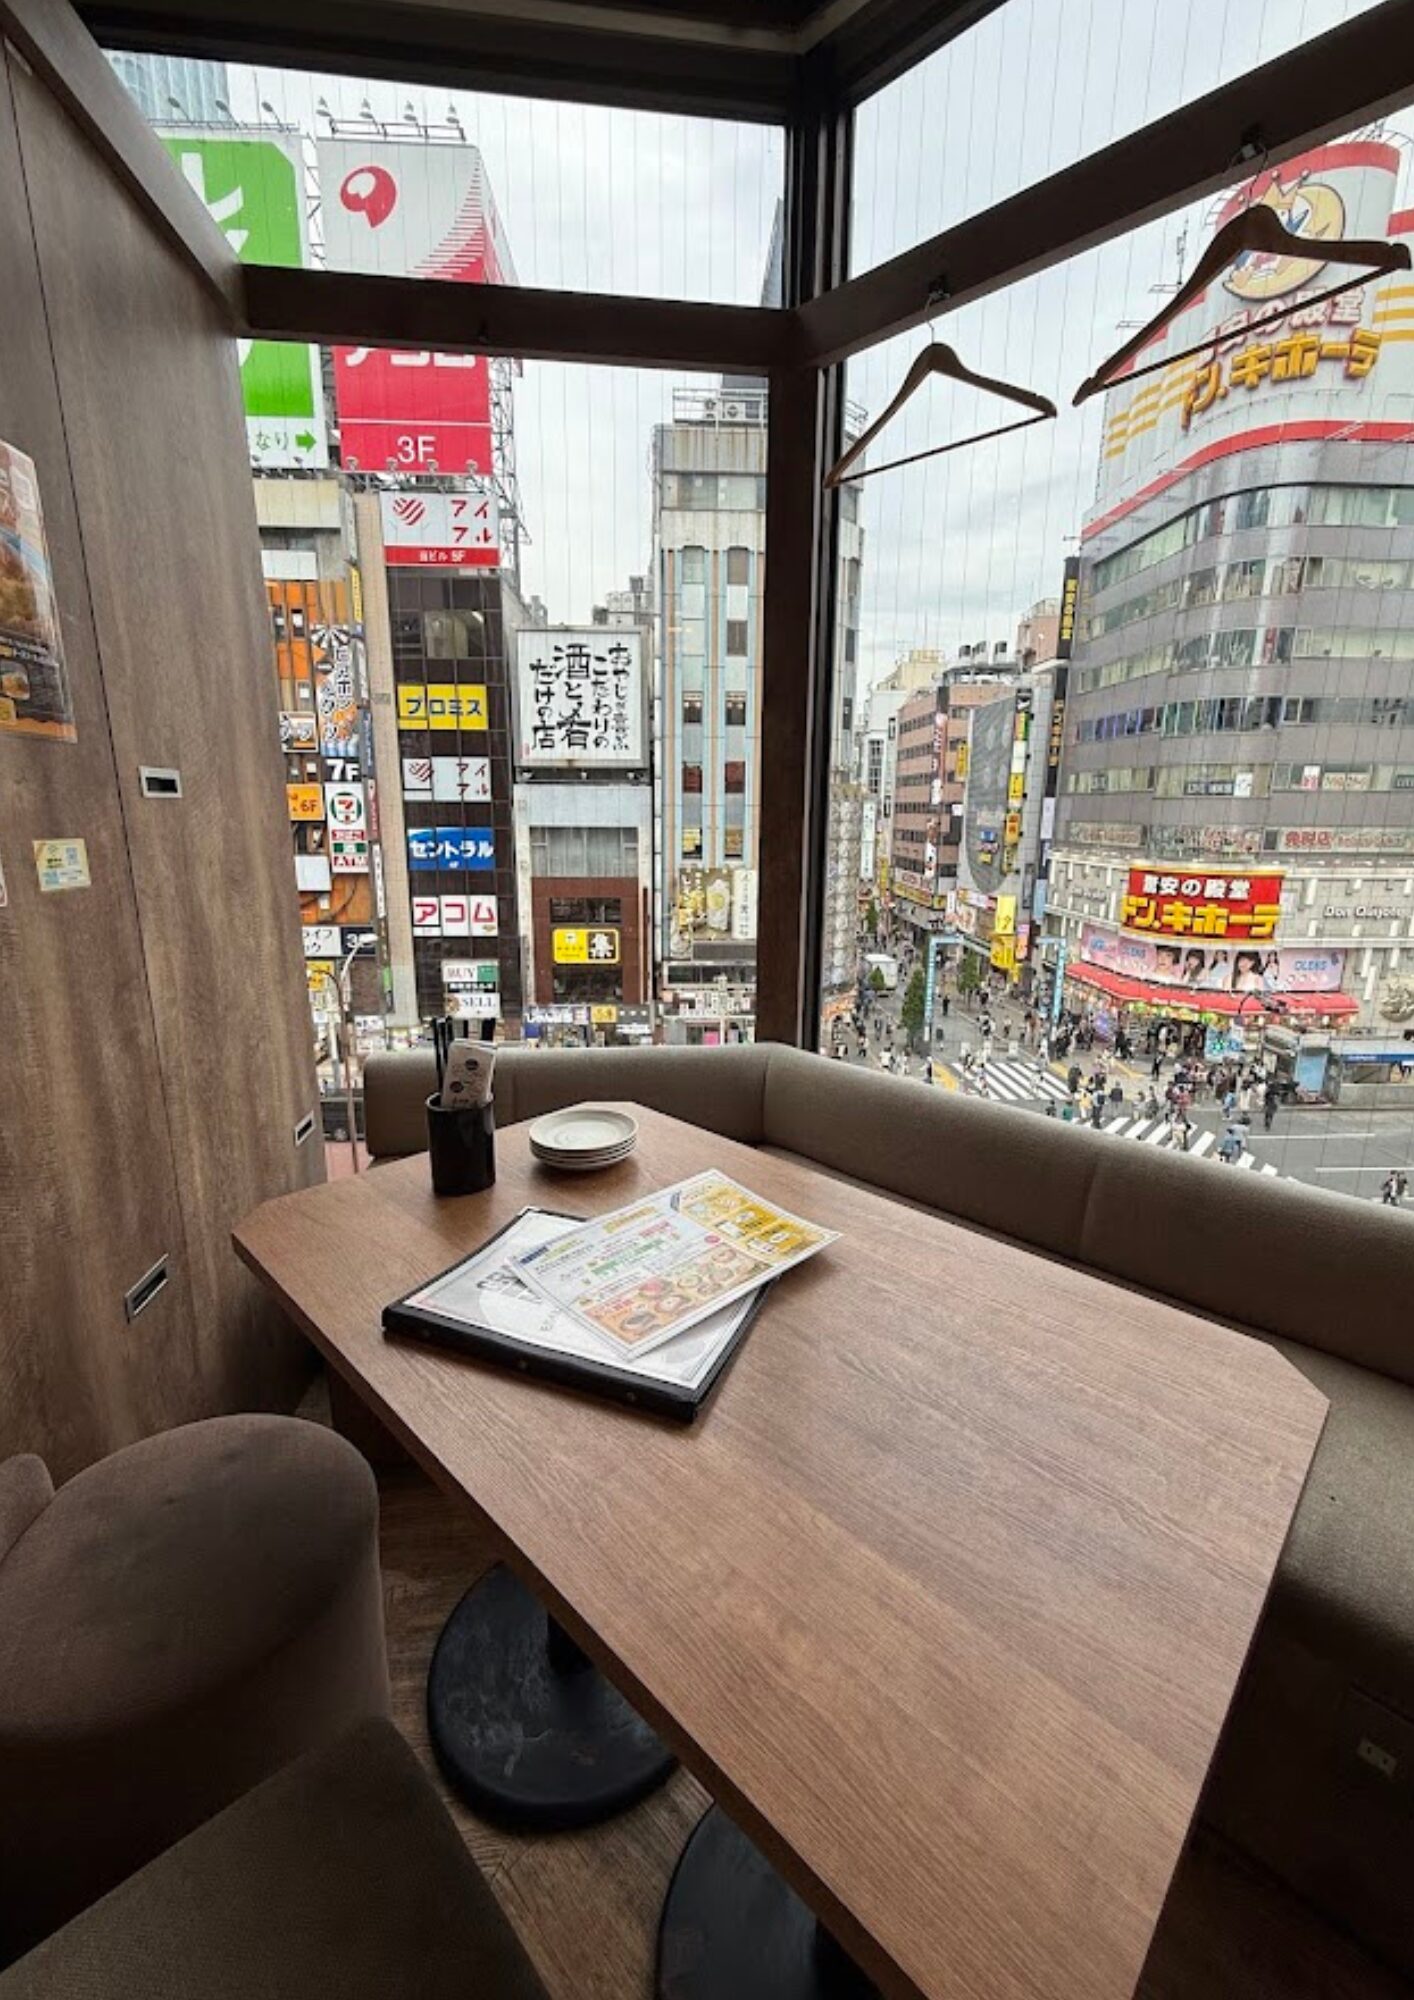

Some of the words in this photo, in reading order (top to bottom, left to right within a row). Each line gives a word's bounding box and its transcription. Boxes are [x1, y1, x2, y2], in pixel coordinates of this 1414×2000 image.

[397, 435, 437, 463] 3F
[405, 695, 483, 716] プロミス
[529, 658, 557, 750] だけの店
[553, 643, 592, 750] 酒と肴
[325, 759, 360, 780] 7F
[300, 799, 318, 813] 6F
[409, 839, 494, 859] セントラル
[415, 902, 495, 924] アコム
